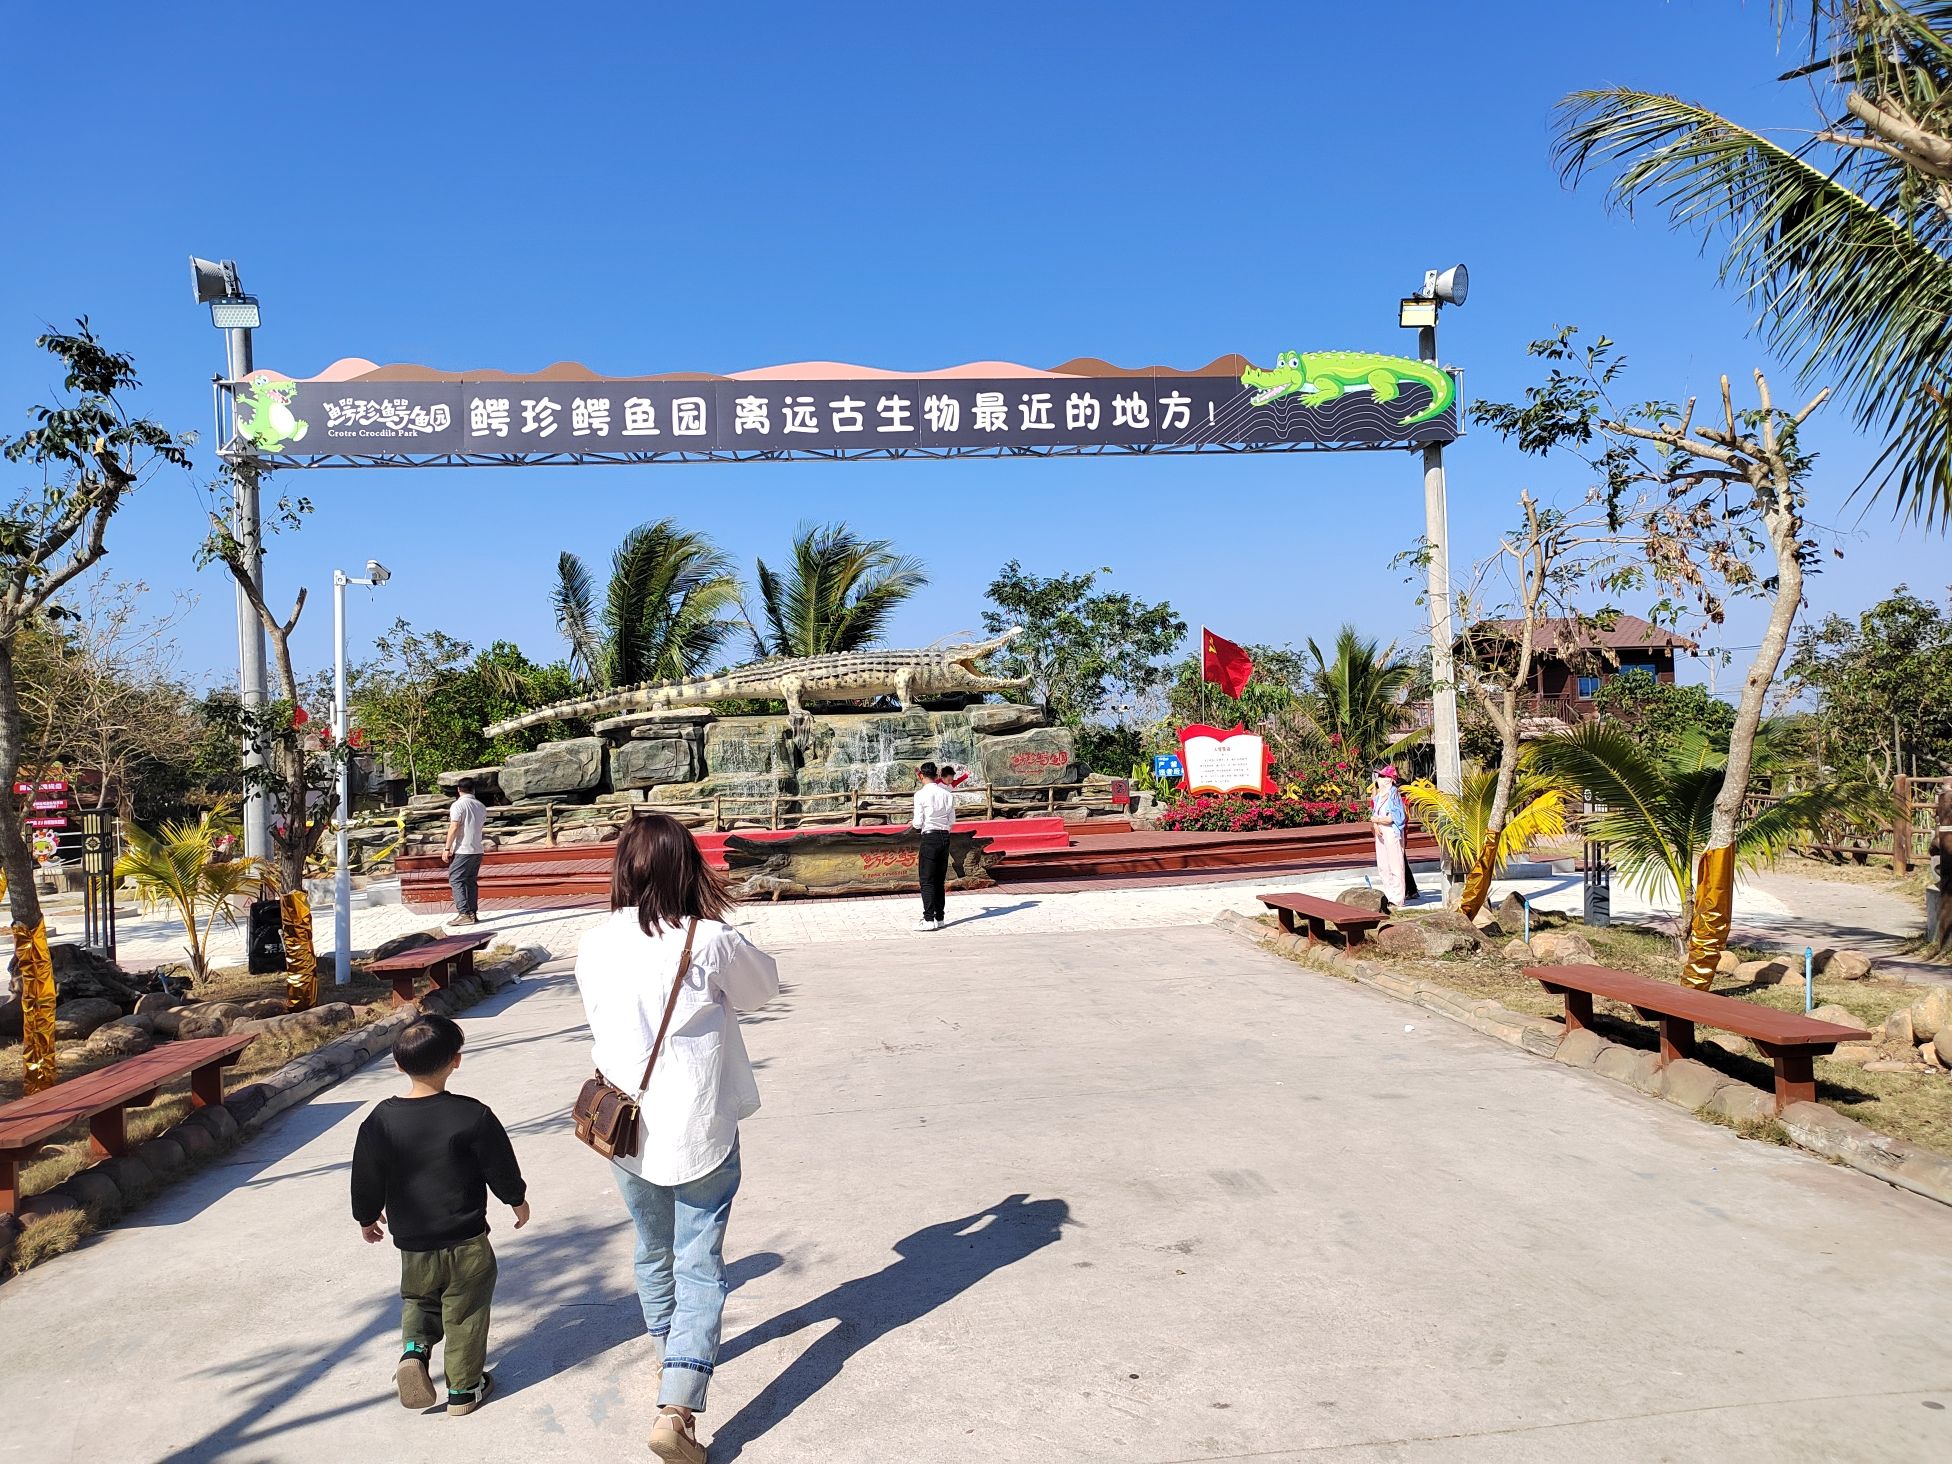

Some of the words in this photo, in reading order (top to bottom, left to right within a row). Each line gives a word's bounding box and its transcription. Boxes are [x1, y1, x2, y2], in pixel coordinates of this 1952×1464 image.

[323, 398, 452, 433] 鳄珍鳄鱼园
[398, 429, 418, 437] Park
[470, 396, 708, 438] 鳄珍鳄鱼园
